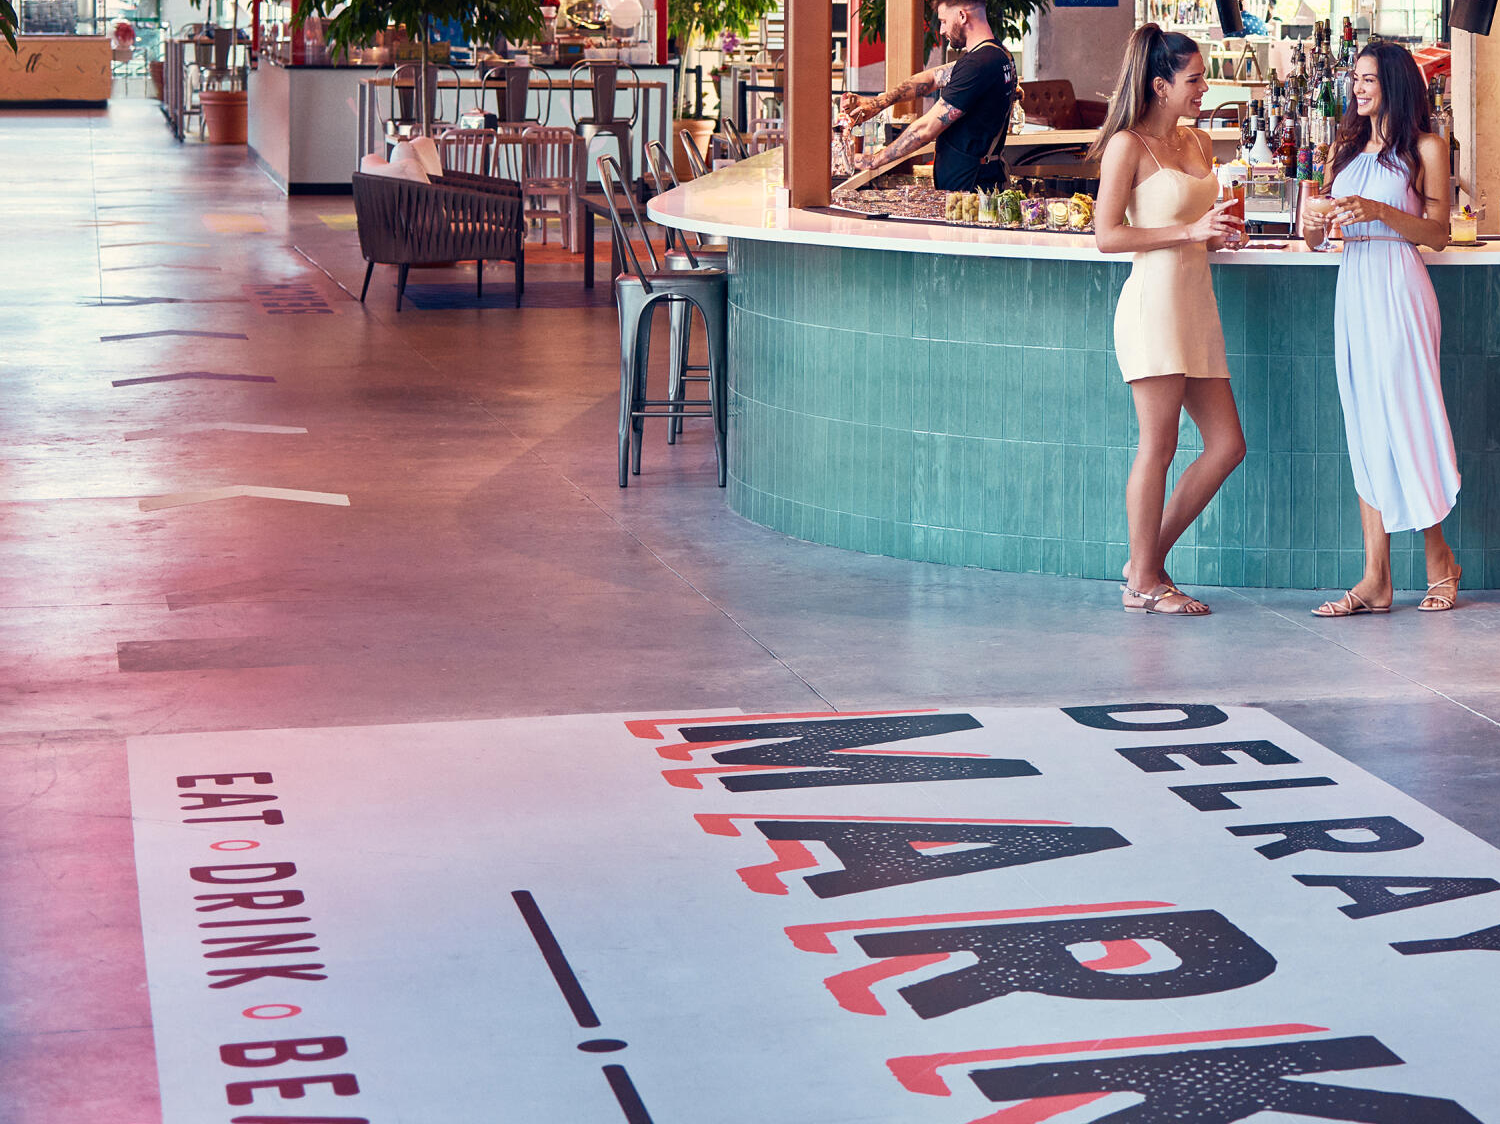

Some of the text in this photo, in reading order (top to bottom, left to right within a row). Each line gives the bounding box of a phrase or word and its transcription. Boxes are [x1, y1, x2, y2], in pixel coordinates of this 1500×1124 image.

[176, 772, 371, 1124] EAT DRINK BE
